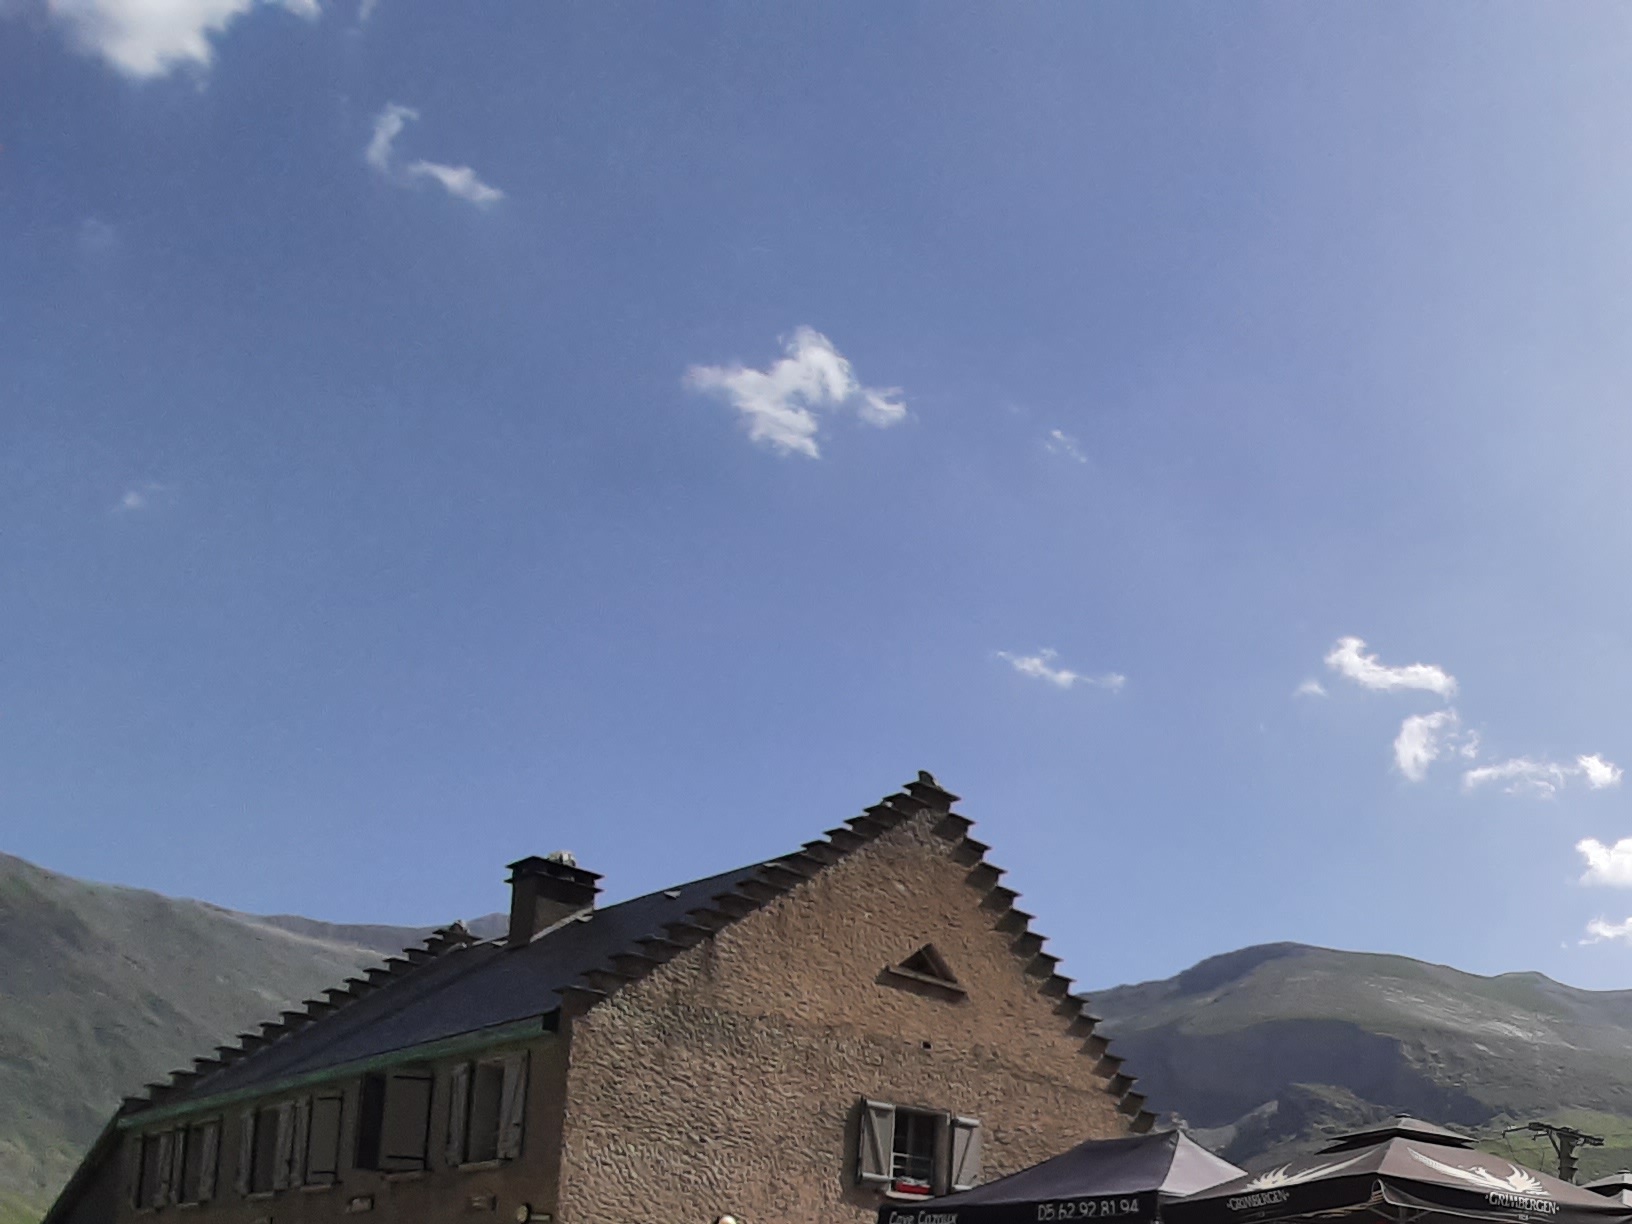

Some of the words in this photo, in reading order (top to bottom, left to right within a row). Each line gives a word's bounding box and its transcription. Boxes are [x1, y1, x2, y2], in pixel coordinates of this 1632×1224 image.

[1038, 1204, 1055, 1221] 05
[1058, 1202, 1075, 1220] 62
[1079, 1201, 1097, 1217] 92
[1100, 1200, 1116, 1217] 81
[1120, 1199, 1139, 1213] 94
[1487, 1191, 1557, 1214] GRIMBERGEN
